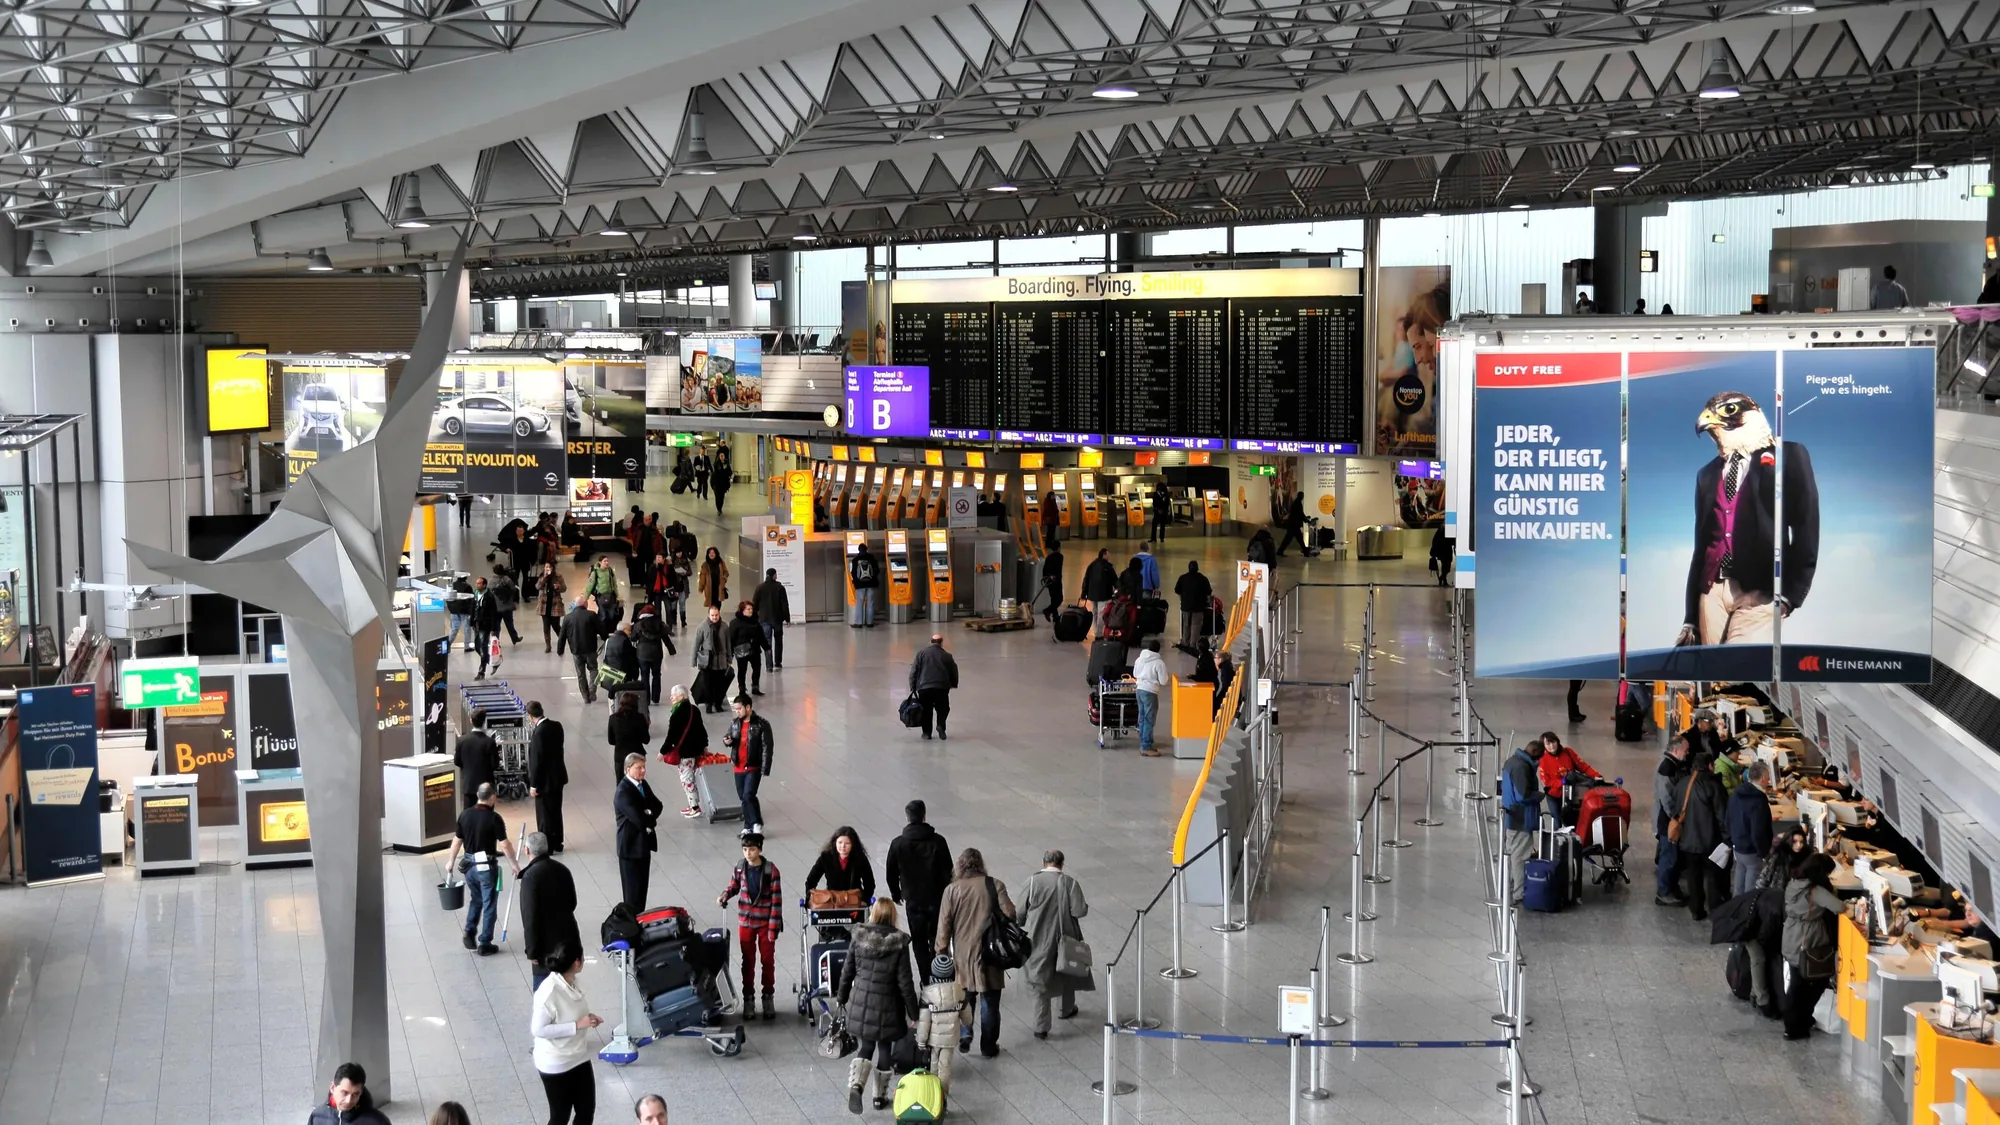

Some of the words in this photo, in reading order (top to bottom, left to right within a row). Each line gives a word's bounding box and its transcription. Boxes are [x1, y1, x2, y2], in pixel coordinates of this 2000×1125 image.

[1008, 277, 1079, 297] Boarding.
[1085, 276, 1136, 296] Flying.
[1141, 273, 1207, 295] Smiling.
[1494, 366, 1528, 375] DUTY
[1532, 366, 1562, 375] FREE
[1805, 374, 1855, 386] Piep-egal,
[1400, 387, 1422, 395] Nonstop
[1403, 393, 1418, 401] you
[1852, 385, 1892, 396] hingeht.
[873, 399, 891, 430] B
[1494, 425, 1560, 447] JEDER,
[1494, 449, 1533, 467] DER
[1538, 449, 1608, 470] FLIEGT,
[1494, 474, 1553, 491] KANN
[1559, 474, 1605, 491] HIER
[1494, 493, 1579, 515] GÜNSTIG
[1494, 522, 1613, 540] EINKAUFEN.
[1826, 658, 1902, 670] HEINEMANN
[175, 743, 236, 773] Bonus
[59, 858, 86, 867] rewards
